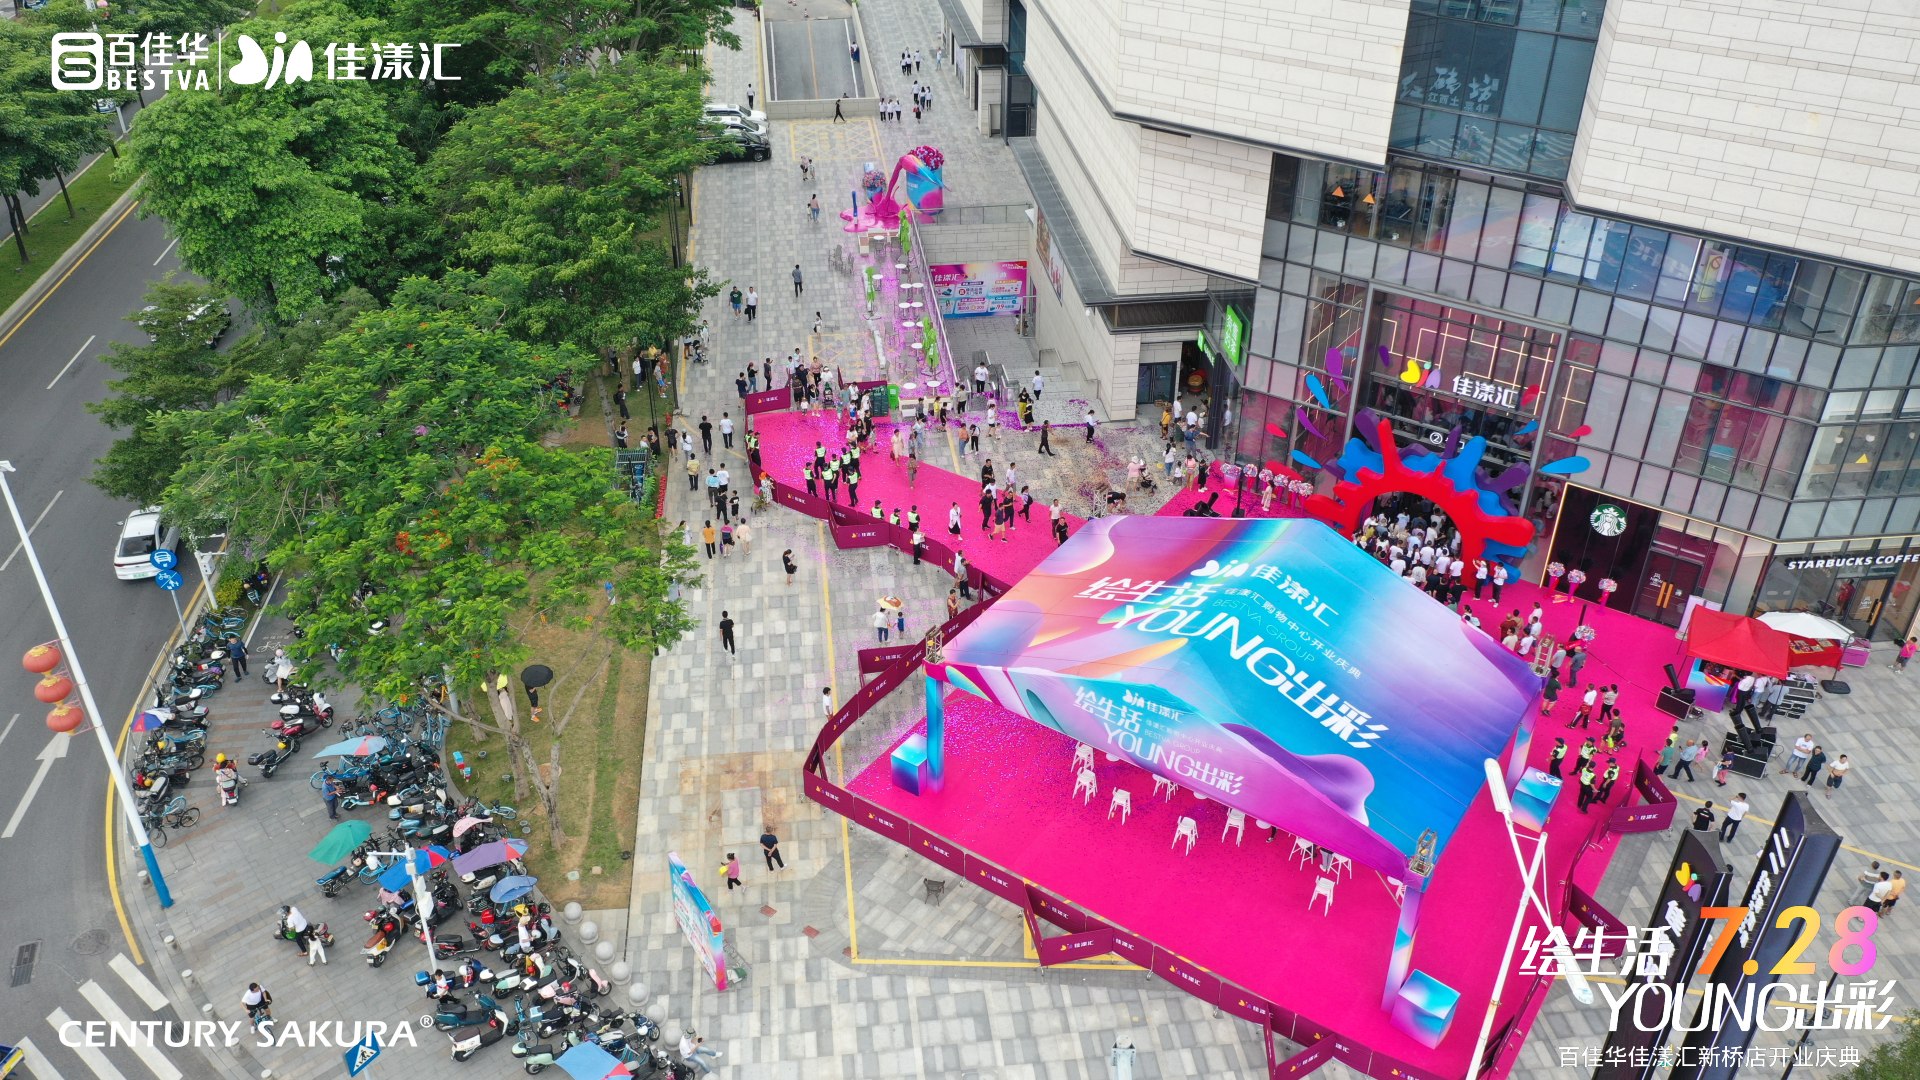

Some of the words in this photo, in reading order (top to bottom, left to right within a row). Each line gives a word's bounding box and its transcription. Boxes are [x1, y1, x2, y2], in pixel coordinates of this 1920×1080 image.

[1452, 375, 1519, 409] 佳漾汇
[1073, 576, 1223, 608] 绘生活
[1250, 563, 1339, 627] 佳漾汇
[1787, 556, 1872, 571] STARBUCKS
[1212, 598, 1262, 628] BESTVA
[1266, 623, 1316, 663] GROUP
[1223, 587, 1362, 681] 佳漾汇购物中心开业庆典
[1113, 605, 1389, 749] YOUNG出彩
[1073, 686, 1143, 733] 绘生活
[1103, 722, 1245, 795] YOUNG出彩
